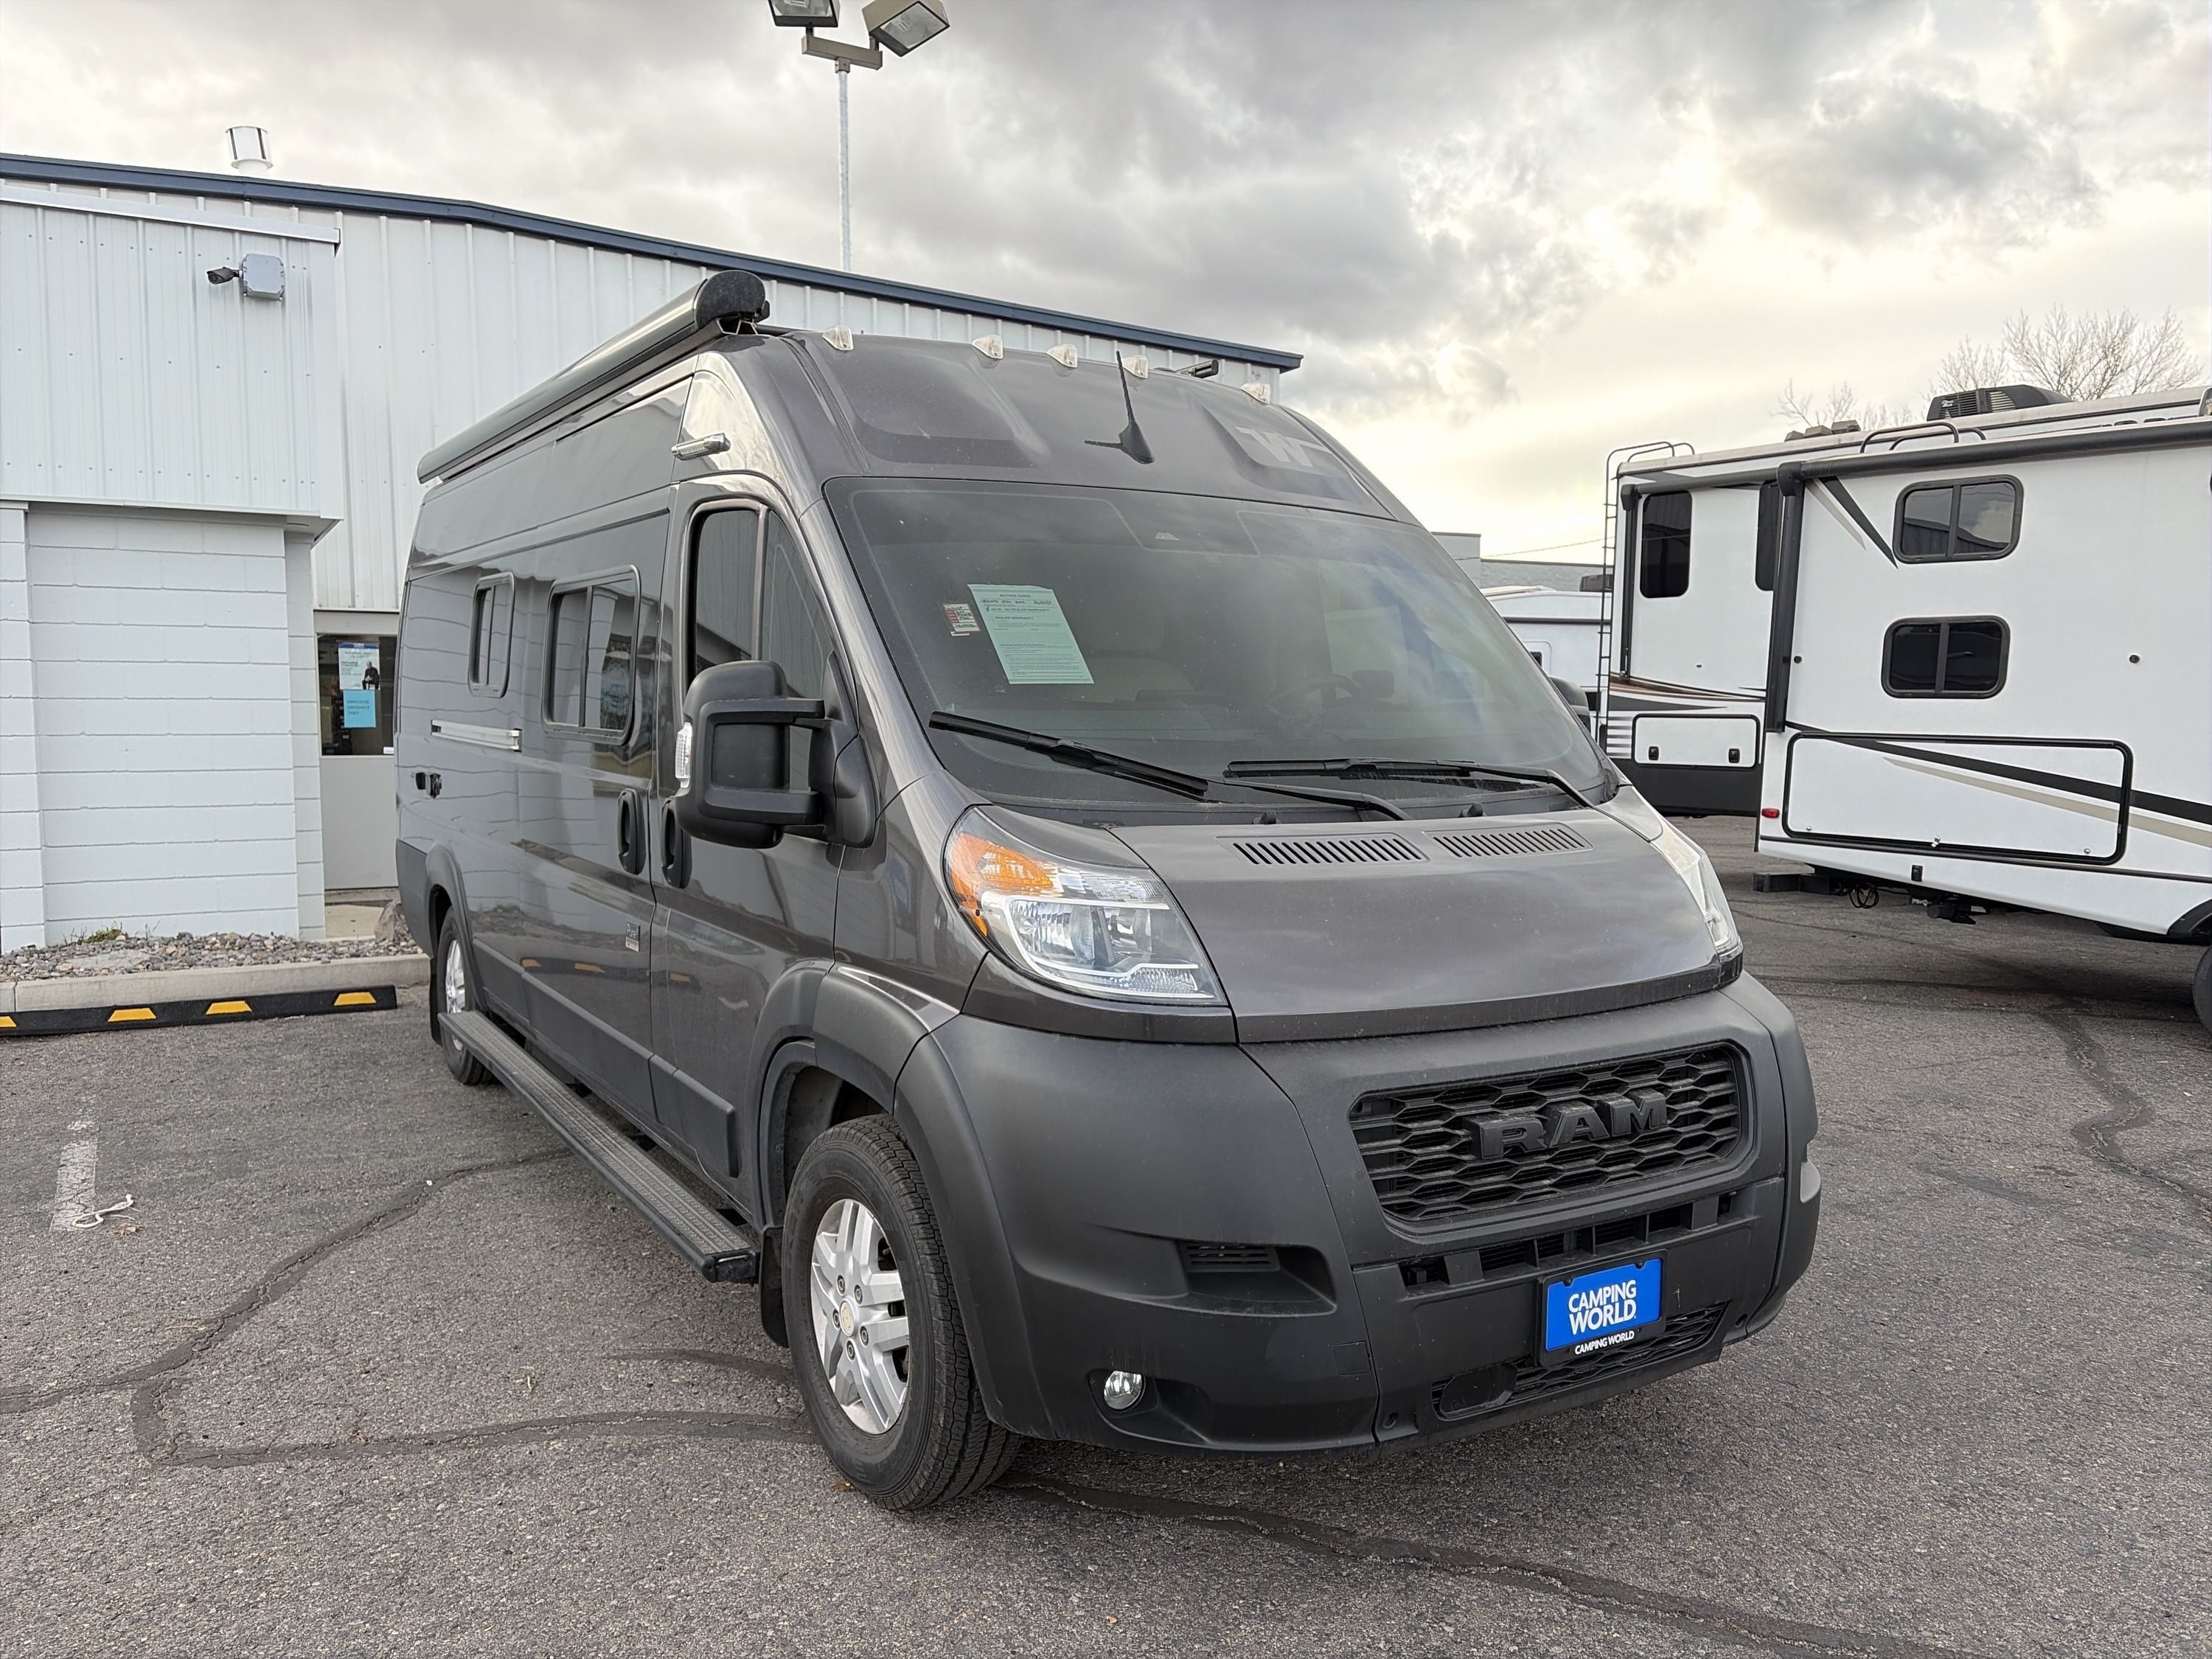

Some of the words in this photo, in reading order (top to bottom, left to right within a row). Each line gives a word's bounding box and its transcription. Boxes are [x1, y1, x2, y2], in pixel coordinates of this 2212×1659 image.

[1473, 1089, 1668, 1160] RAM
[1568, 1280, 1637, 1313] CAMPING
[1569, 1299, 1637, 1335] WORLD
[1574, 1337, 1608, 1355] CAMPING
[1608, 1330, 1635, 1346] WORLD
